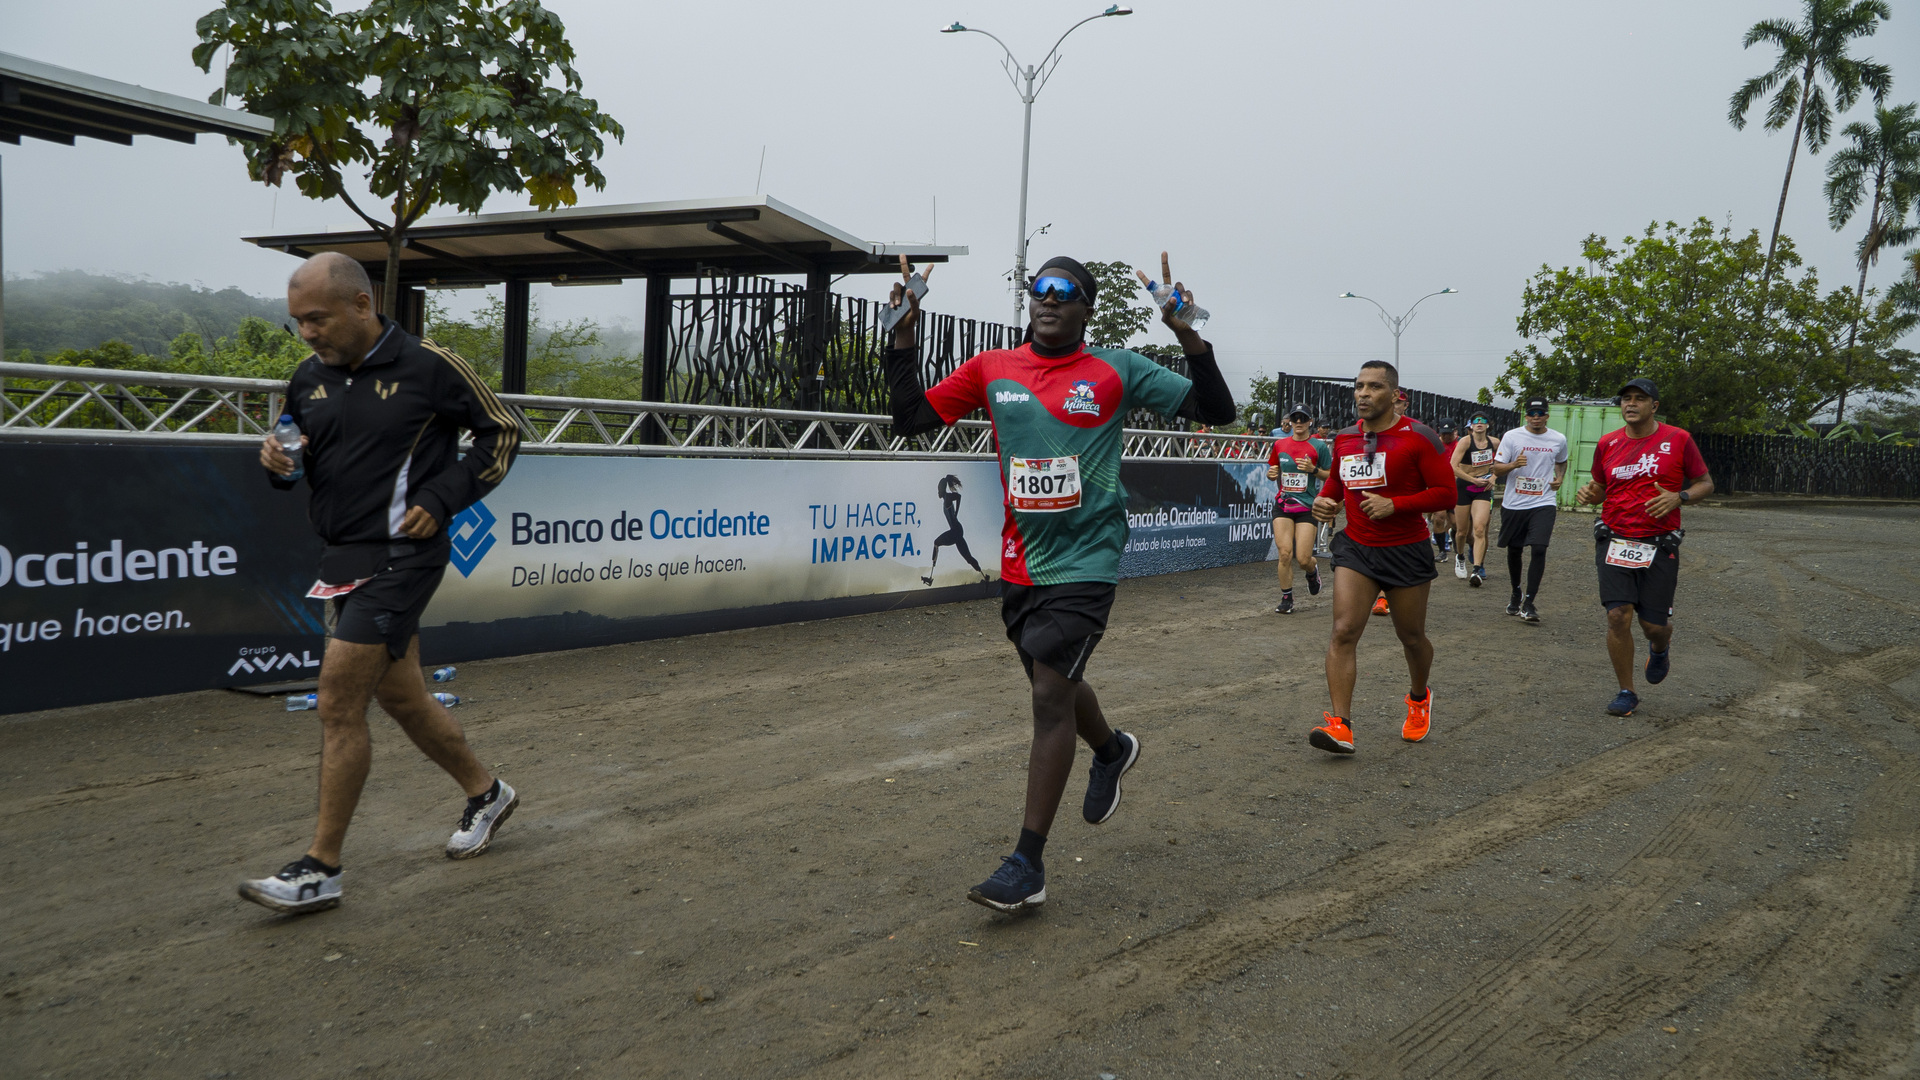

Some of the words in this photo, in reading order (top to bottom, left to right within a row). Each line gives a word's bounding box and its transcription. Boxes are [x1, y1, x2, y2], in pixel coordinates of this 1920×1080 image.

[1350, 464, 1372, 478] 540
[1017, 474, 1067, 495] 1807
[1285, 479, 1301, 487] 192
[1522, 482, 1537, 491] 339
[808, 504, 837, 530] TU
[846, 502, 921, 528] HACER,
[1125, 508, 1154, 529] anco
[1155, 507, 1169, 527] de
[1170, 506, 1217, 527] Occidente
[1228, 503, 1241, 520] TU
[512, 512, 604, 546] Banco
[611, 510, 643, 542] de
[649, 508, 770, 540] Occidente
[1228, 522, 1274, 543] IMPACTA.
[811, 532, 921, 565] IMPACTA.
[1125, 539, 1133, 553] el
[1133, 538, 1150, 552] lado
[1150, 537, 1160, 550] de
[1160, 536, 1171, 549] los
[1171, 539, 1185, 551] que
[1185, 534, 1207, 548] hacen.
[1619, 549, 1643, 561] 462
[512, 563, 546, 588] Del
[551, 561, 595, 585] lado
[599, 559, 623, 581] de
[628, 557, 653, 579] los
[658, 560, 690, 582] que
[694, 554, 747, 574] hacen.
[0, 619, 62, 653] que
[74, 608, 192, 639] hacen.
[239, 645, 277, 657] Grupo
[227, 650, 321, 678] AVAL
